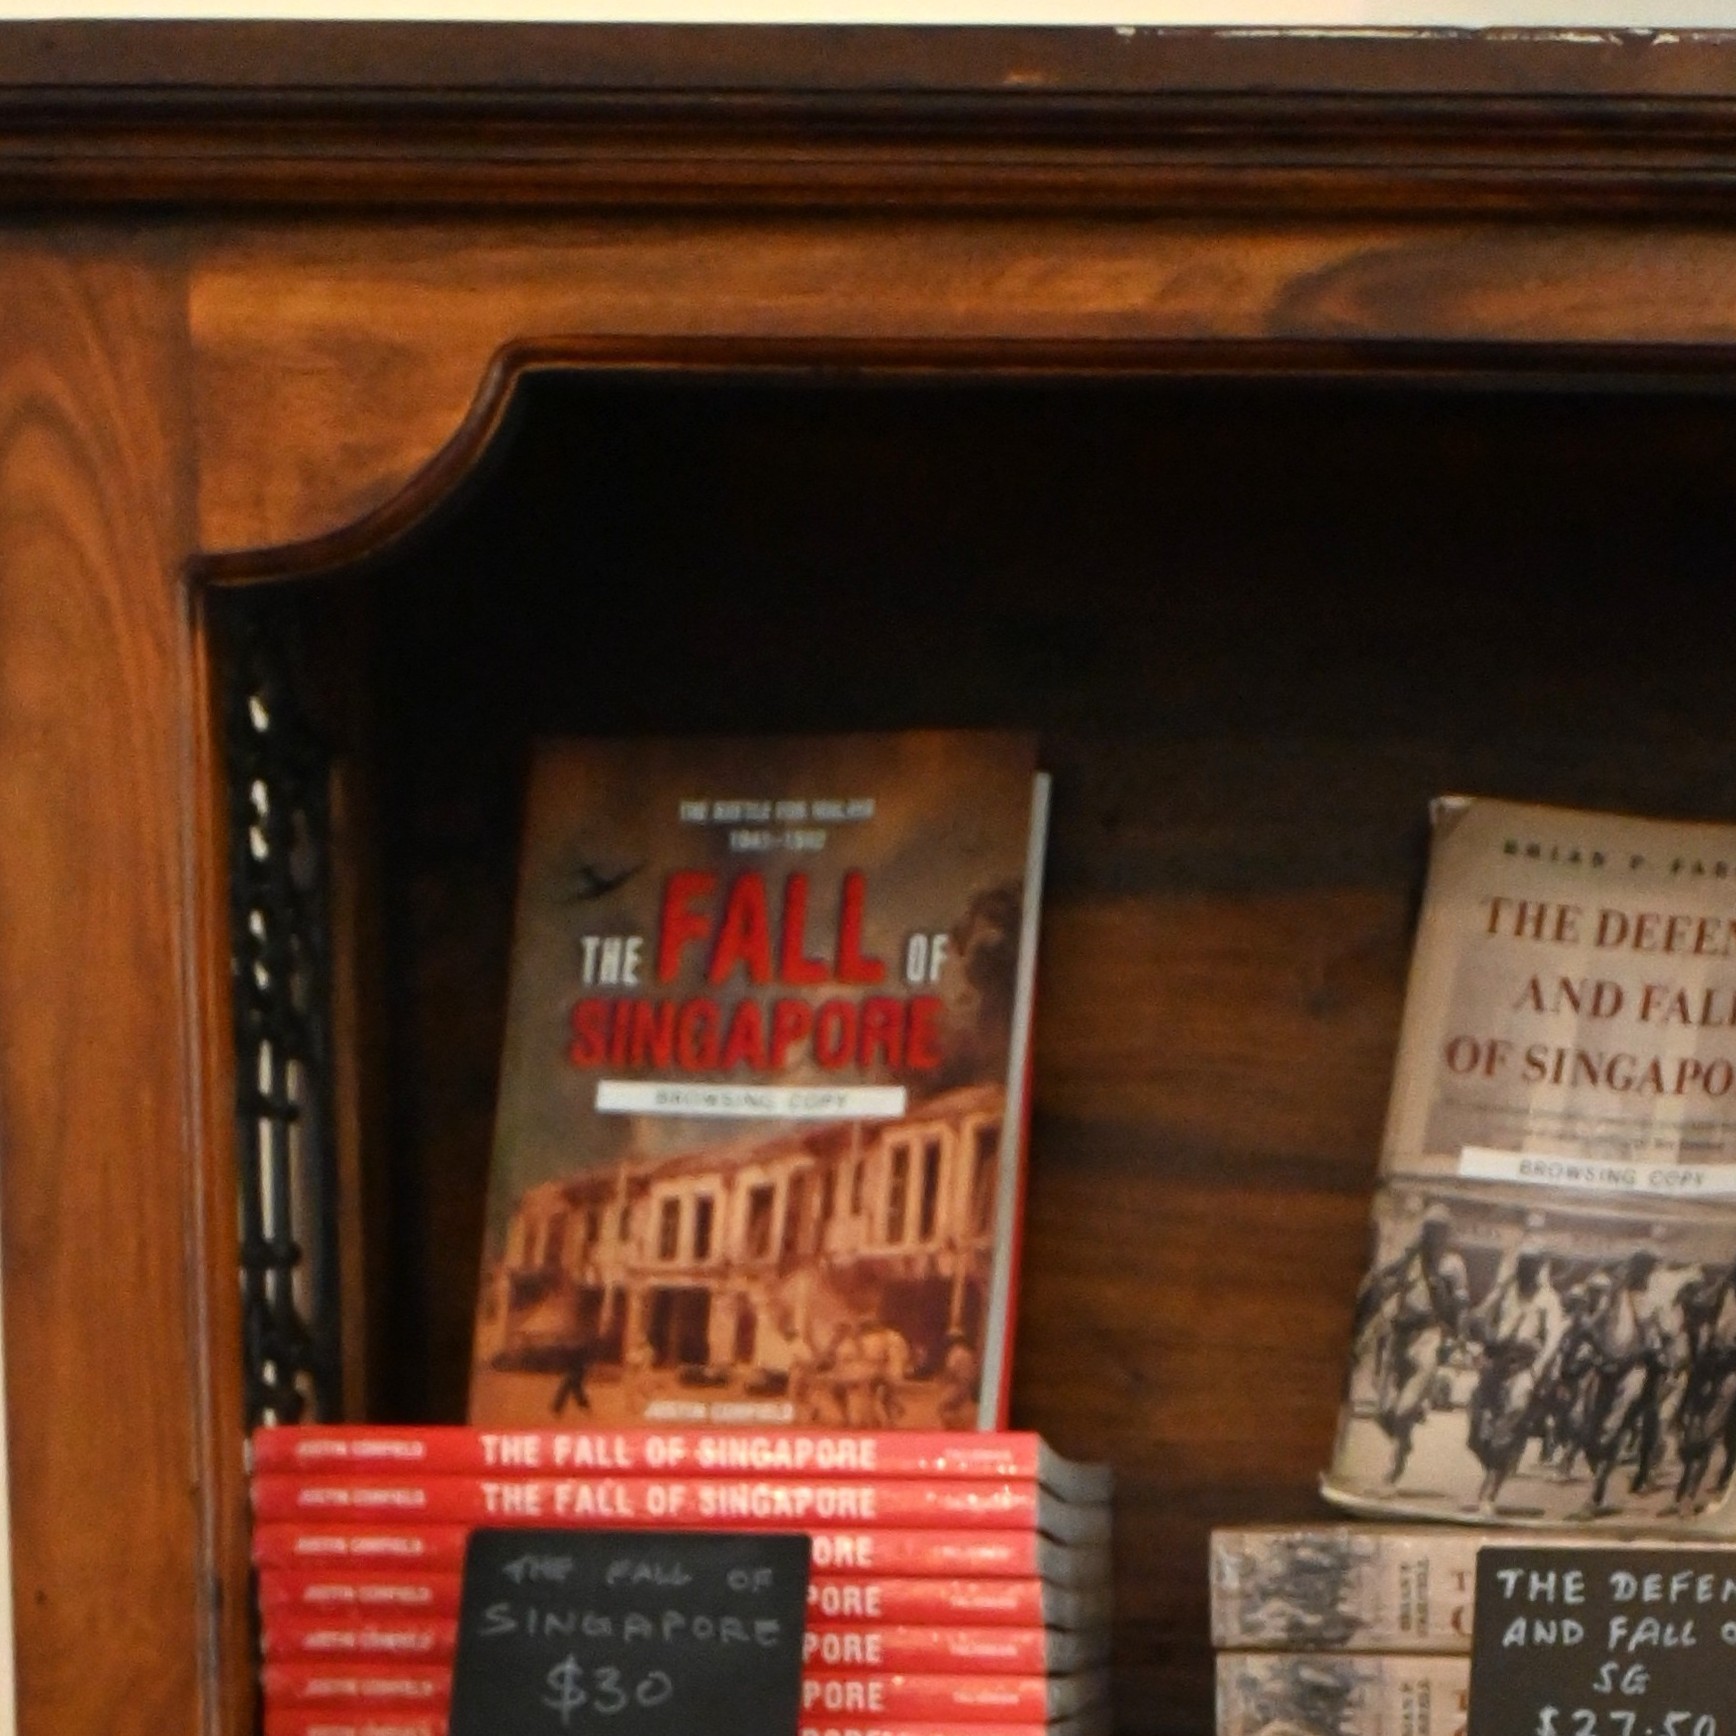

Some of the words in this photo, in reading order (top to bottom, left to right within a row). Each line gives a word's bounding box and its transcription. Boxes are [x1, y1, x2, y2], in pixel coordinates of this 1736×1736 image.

[581, 936, 643, 987] THE
[657, 872, 885, 986] FALL
[906, 933, 949, 983] OF
[1483, 896, 1582, 943] THE
[1514, 974, 1624, 1021] AND
[570, 997, 943, 1070] SINGAPORE
[1445, 1035, 1512, 1079] OF
[480, 1434, 541, 1466] THE
[553, 1435, 630, 1467] FALL
[645, 1436, 686, 1468] OF
[698, 1437, 878, 1470] SINGAPORE
[480, 1481, 541, 1515] THE
[553, 1481, 632, 1517] FALL
[645, 1483, 687, 1518] OF
[698, 1484, 878, 1519] SINGAPORE
[1497, 1570, 1585, 1602] THE
[480, 1603, 779, 1648] SINGAPORE
[1502, 1617, 1583, 1648] AND
[1608, 1617, 1698, 1649] FALL
[544, 1653, 673, 1726] $30
[1592, 1662, 1650, 1696] SG
